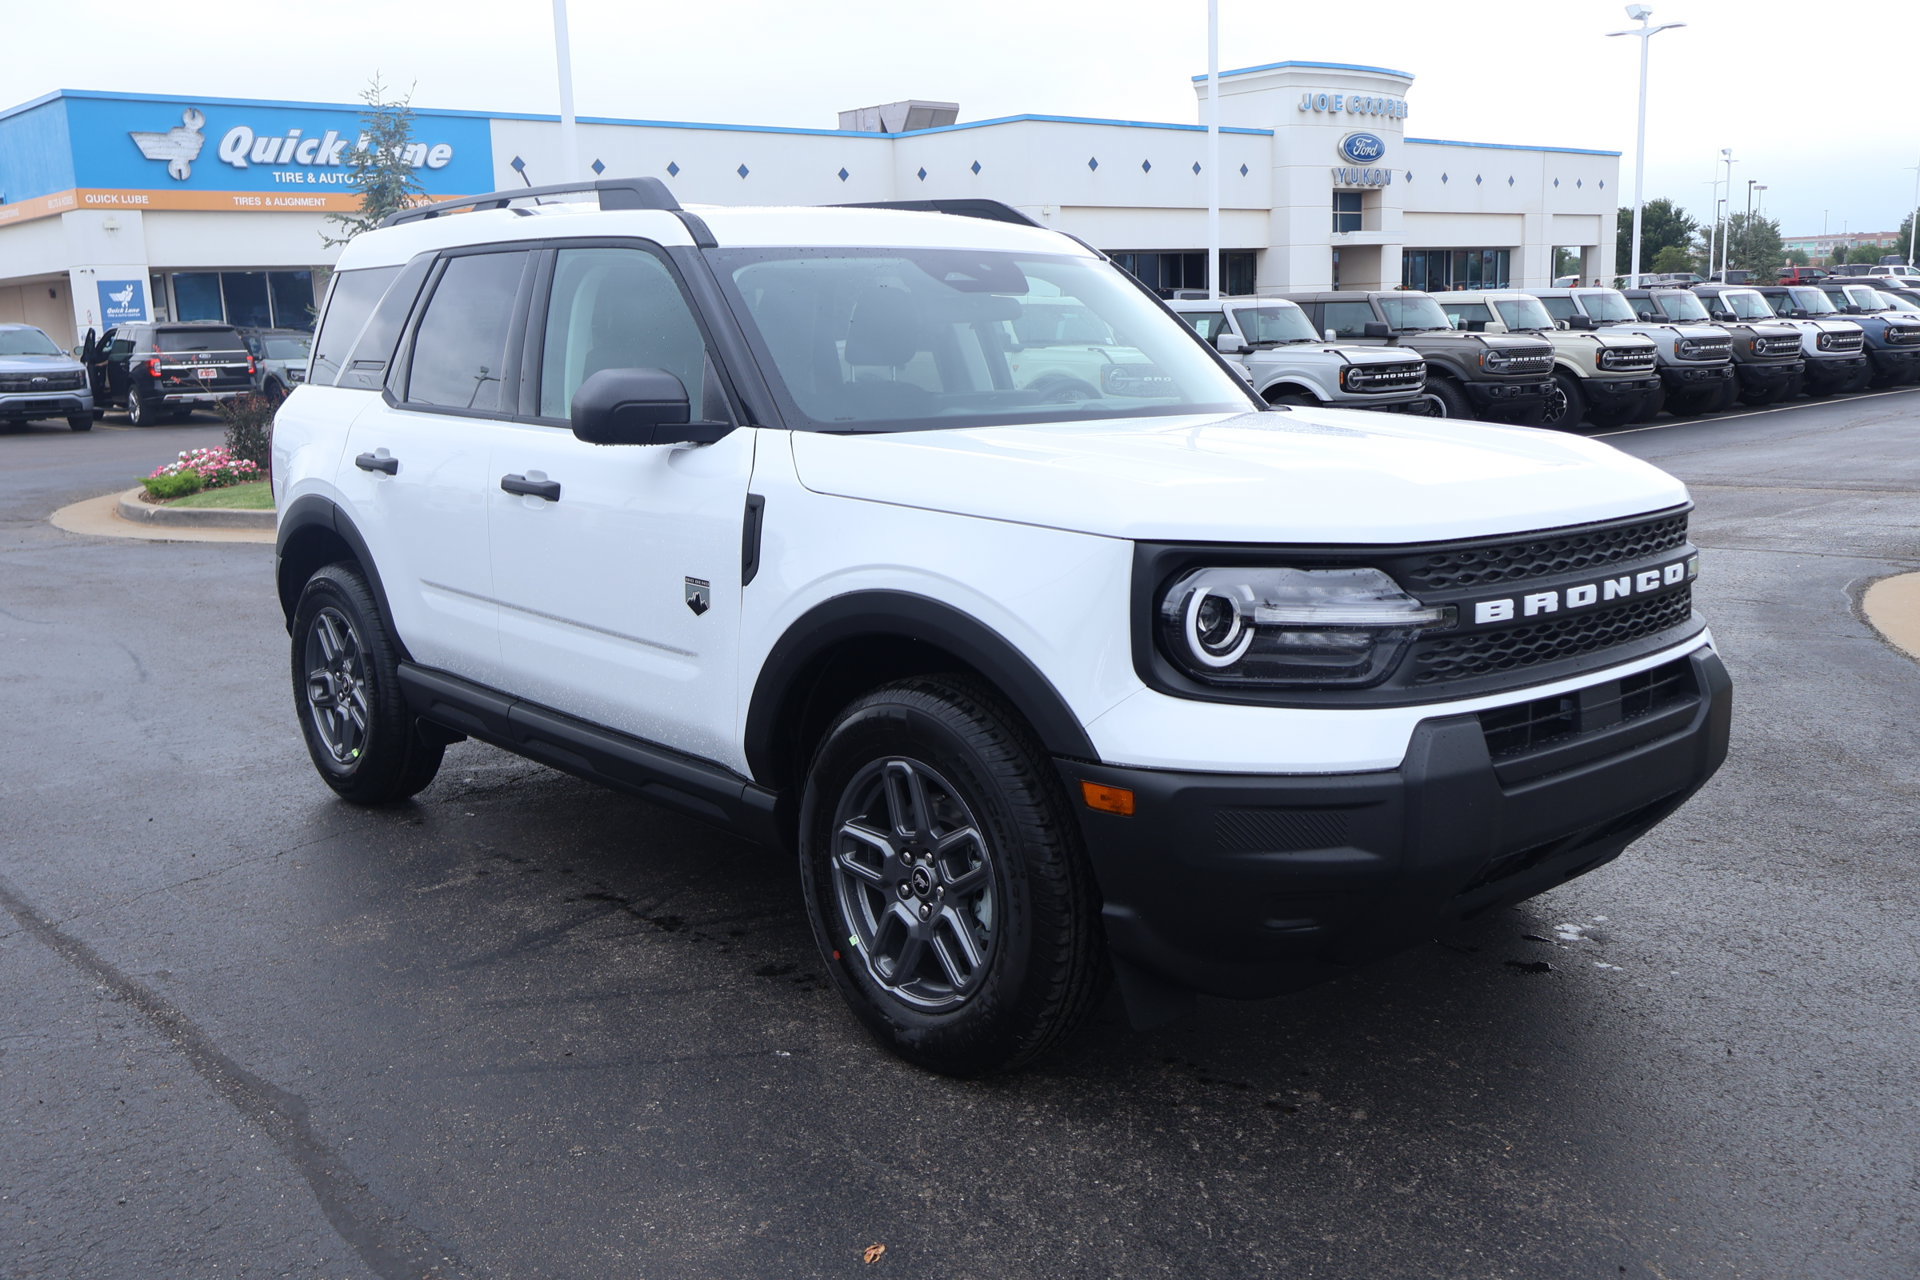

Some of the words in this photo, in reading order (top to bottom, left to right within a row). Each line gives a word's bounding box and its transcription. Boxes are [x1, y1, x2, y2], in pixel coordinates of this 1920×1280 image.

[1299, 93, 1343, 112] JOE
[1348, 95, 1408, 119] COOPER
[217, 125, 349, 169] Quick
[1352, 137, 1379, 156] Ford
[273, 172, 304, 183] TIRE
[307, 173, 316, 183] &
[319, 173, 354, 184] AUTO
[1334, 168, 1392, 186] YUKON
[85, 194, 118, 204] QUICK
[121, 195, 149, 204] LUBE
[233, 196, 261, 206] TIRES
[265, 197, 272, 206] &
[274, 197, 326, 206] ALIGNMENT
[1474, 562, 1684, 625] BRONCO
